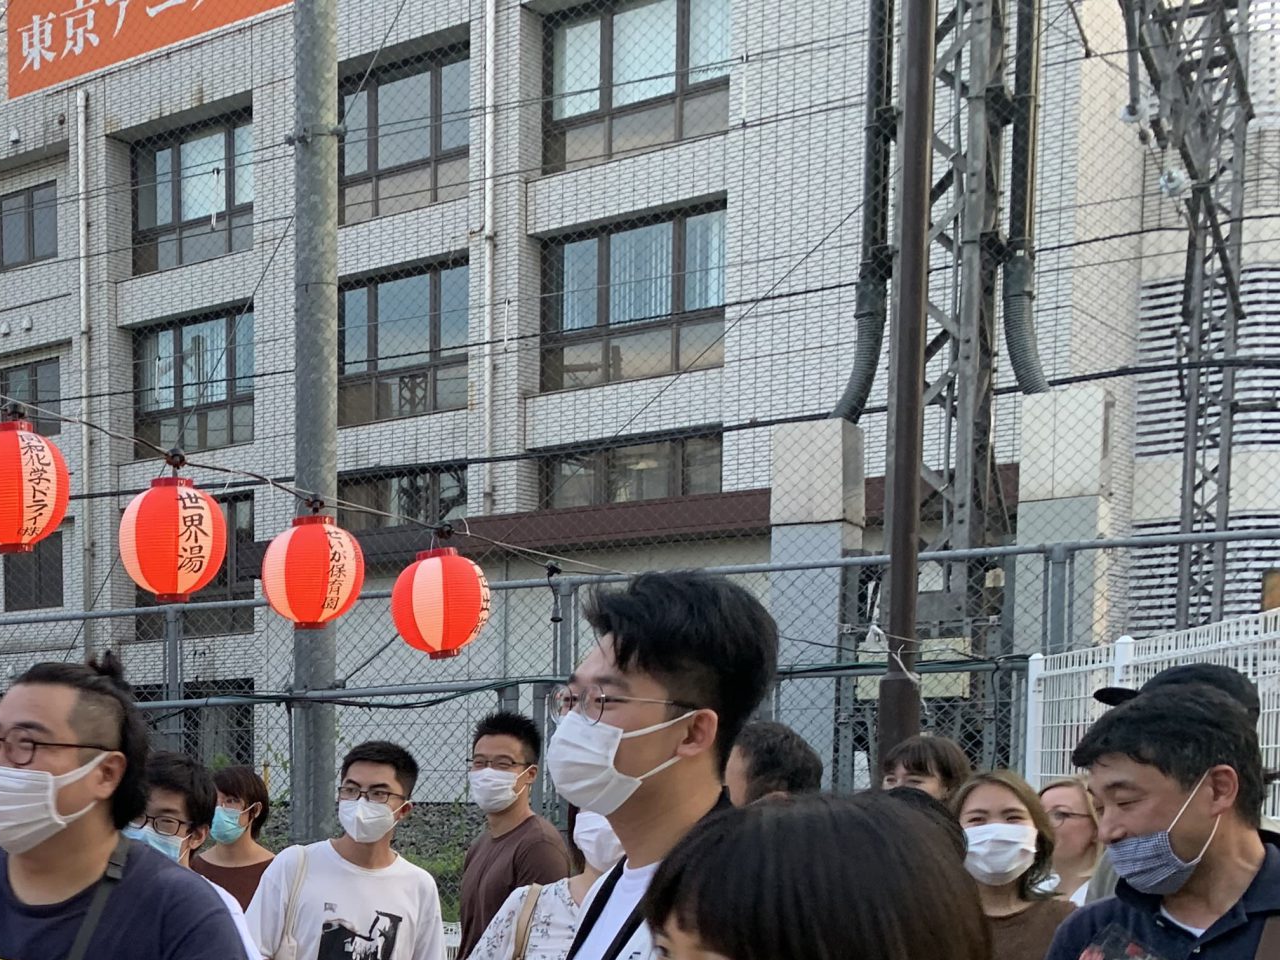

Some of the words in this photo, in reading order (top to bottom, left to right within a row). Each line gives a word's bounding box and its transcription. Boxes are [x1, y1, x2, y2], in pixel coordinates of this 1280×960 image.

[176, 492, 210, 574] 世界湯
[322, 530, 346, 610] せいが保育園
